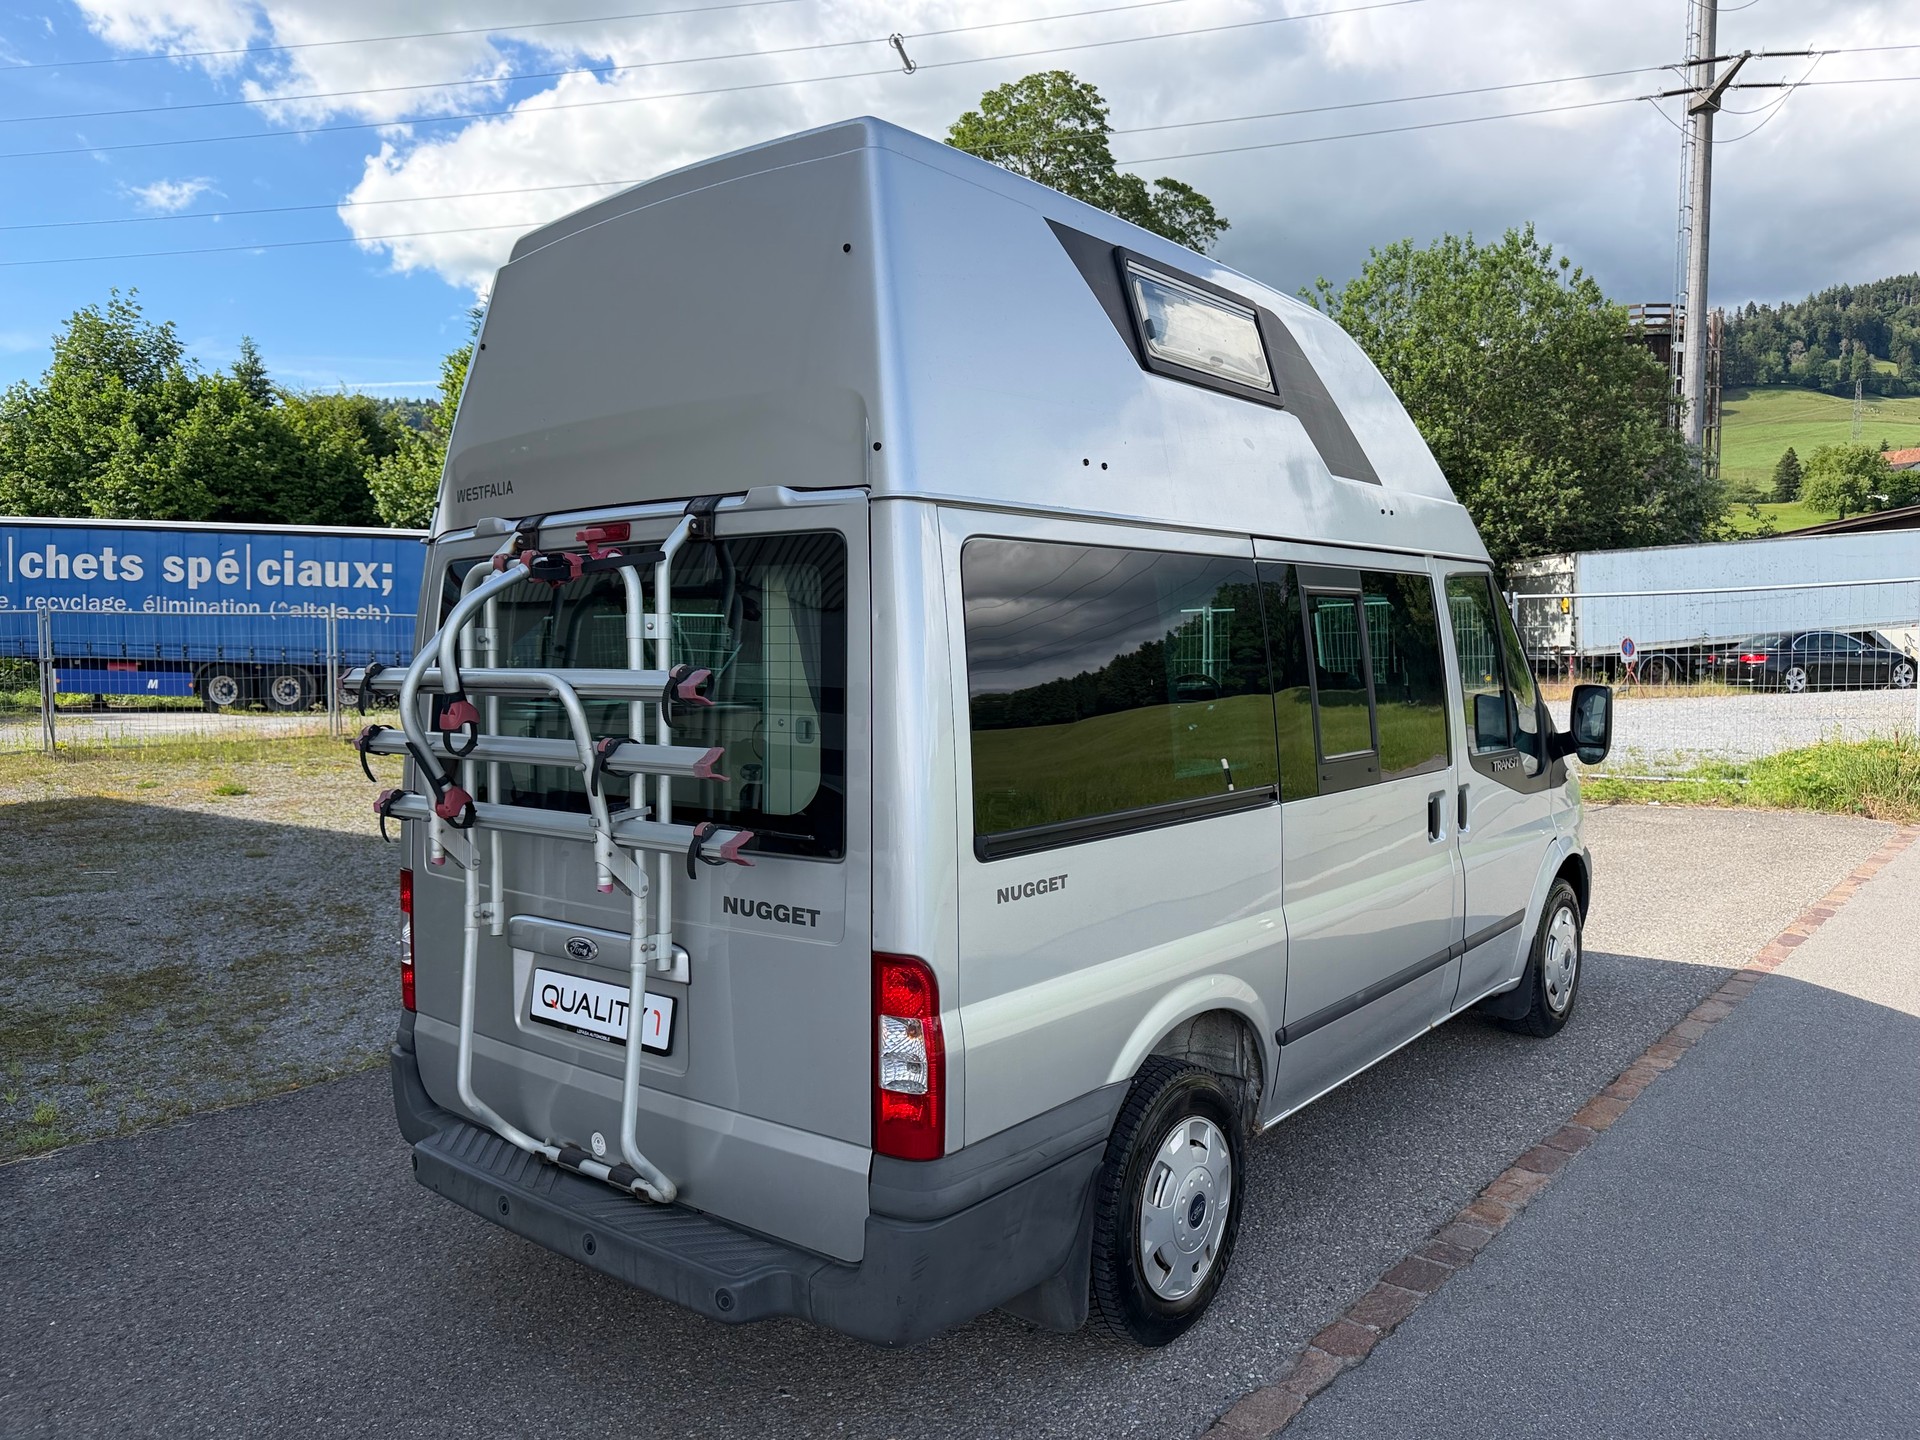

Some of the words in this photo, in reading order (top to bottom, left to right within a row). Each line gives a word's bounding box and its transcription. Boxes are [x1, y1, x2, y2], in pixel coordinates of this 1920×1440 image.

[456, 480, 514, 503] WESTFALIA
[143, 595, 261, 615] élimination
[1491, 756, 1519, 772] TRANSIT
[997, 873, 1069, 905] NUGGET
[723, 895, 821, 928] NUGGET
[541, 983, 649, 1027] QUALIT
[653, 1009, 661, 1036] 1
